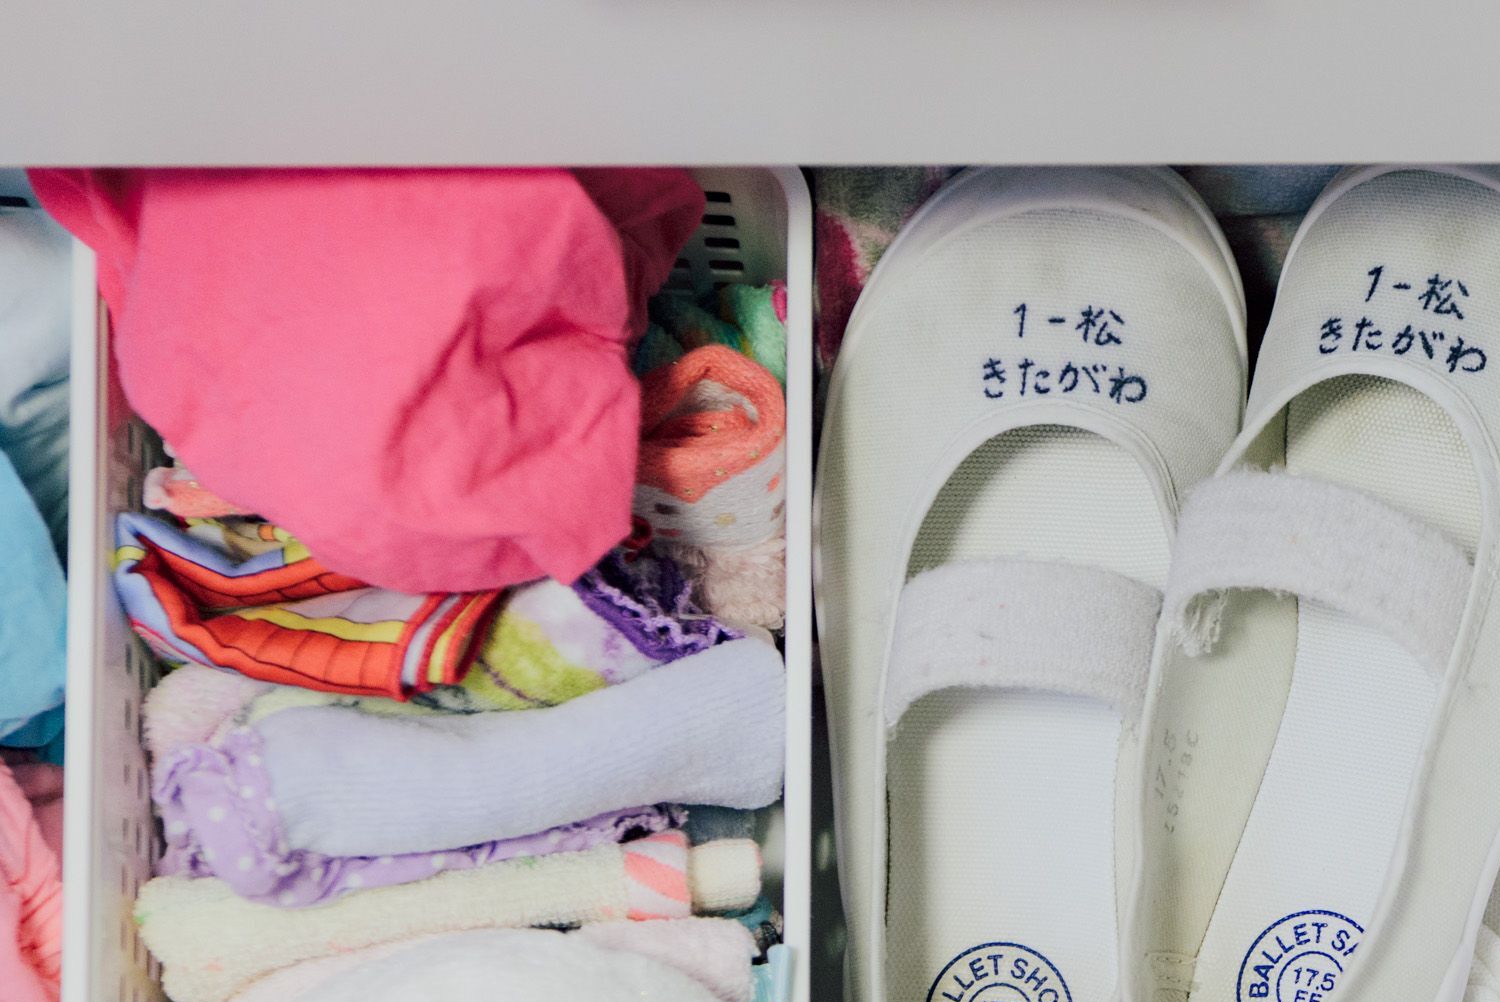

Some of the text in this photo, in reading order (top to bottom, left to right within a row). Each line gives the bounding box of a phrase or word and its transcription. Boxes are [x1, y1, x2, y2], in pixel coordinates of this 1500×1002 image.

[1318, 316, 1488, 373] きたがわ
[982, 358, 1148, 404] きたがわ
[1248, 922, 1328, 998] BALLET
[1293, 967, 1337, 992] 17.5
